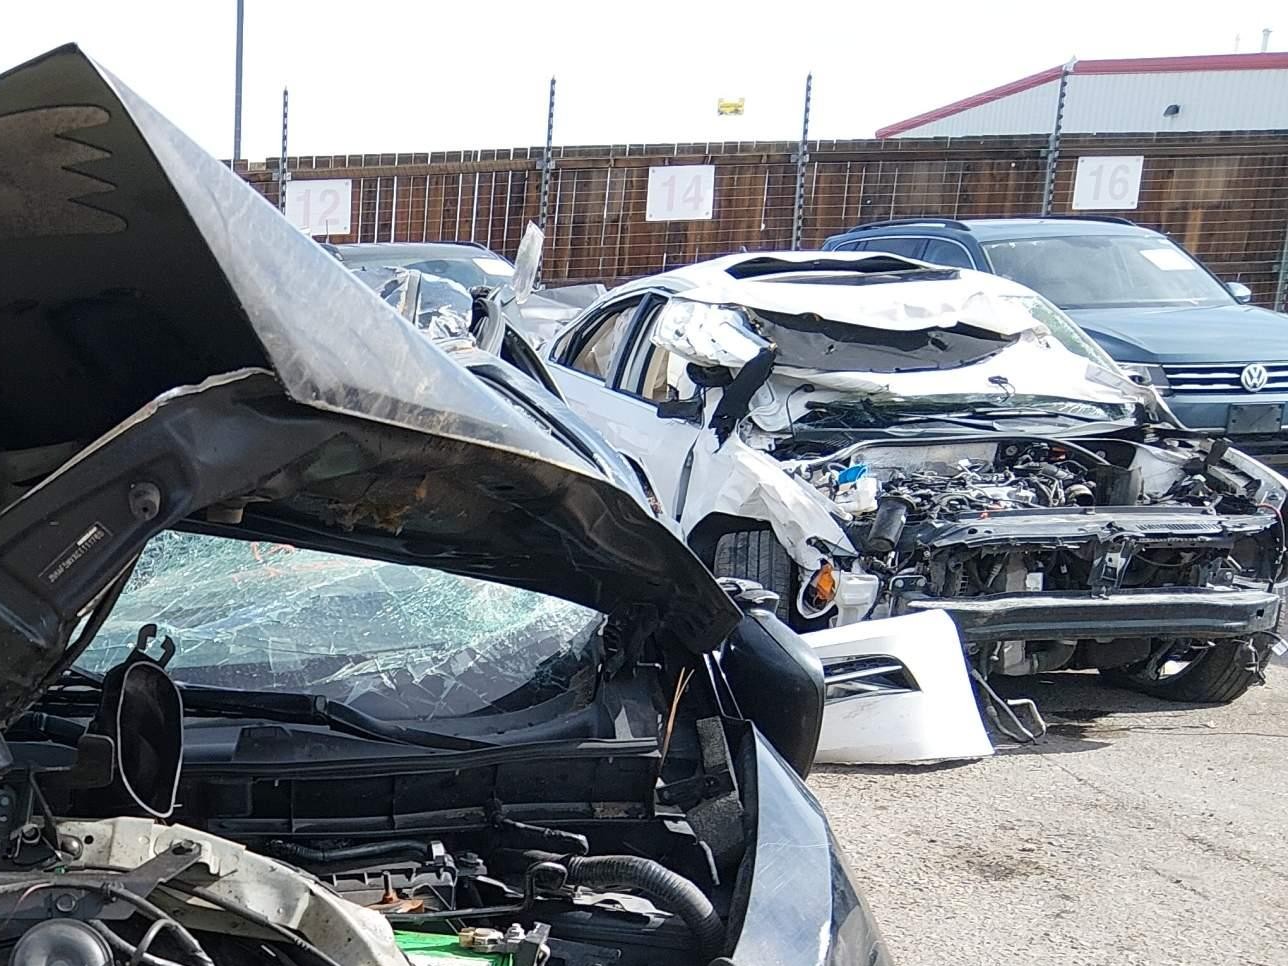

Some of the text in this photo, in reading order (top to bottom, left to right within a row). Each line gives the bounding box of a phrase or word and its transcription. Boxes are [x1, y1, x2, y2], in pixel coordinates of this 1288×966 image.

[660, 174, 705, 212] 14
[1089, 164, 1130, 201] 16
[296, 189, 341, 229] 12
